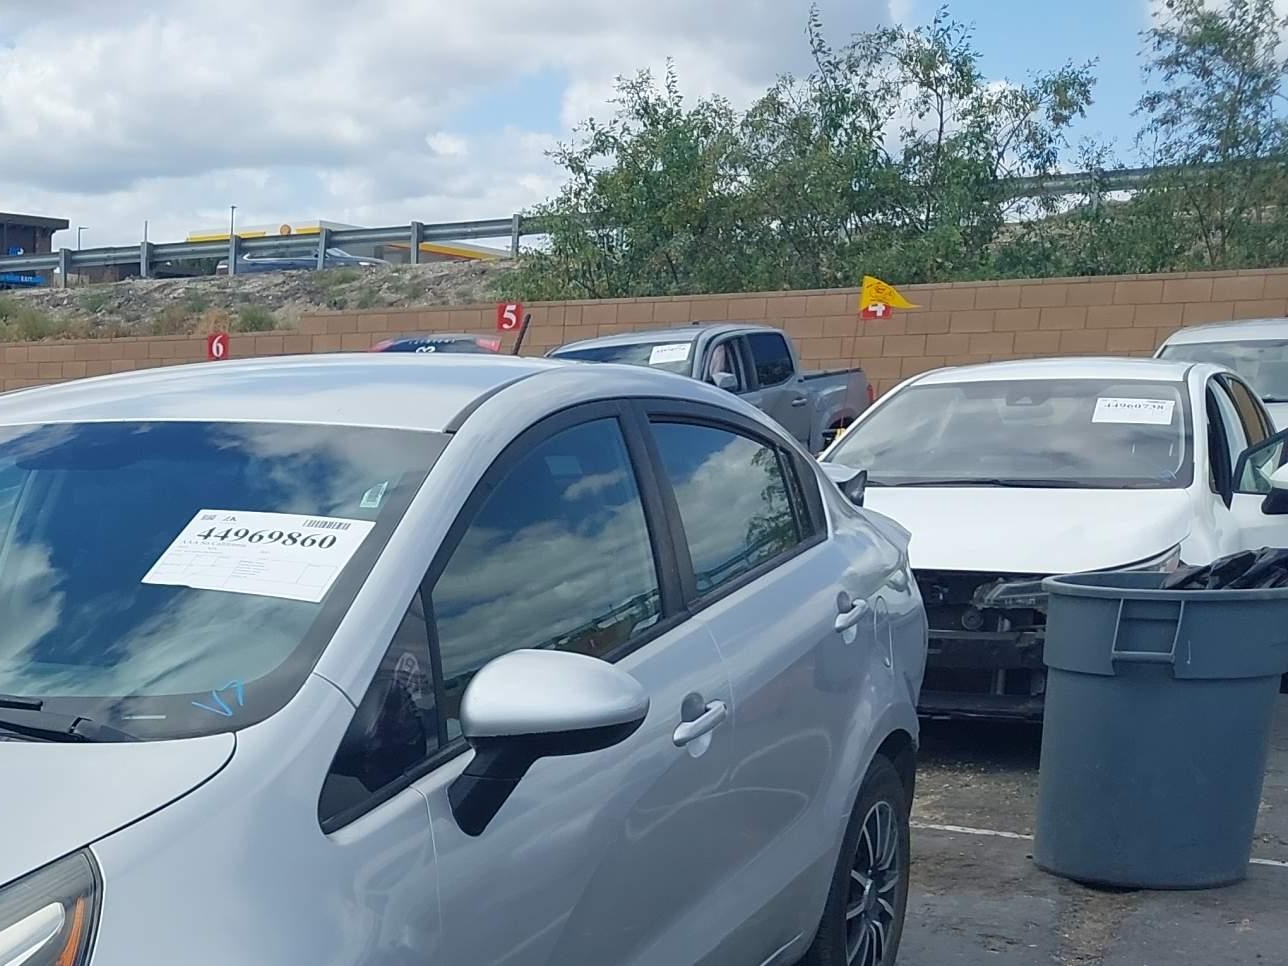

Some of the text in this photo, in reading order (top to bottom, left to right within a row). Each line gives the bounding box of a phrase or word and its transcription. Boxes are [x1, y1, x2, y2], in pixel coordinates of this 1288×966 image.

[502, 304, 517, 329] 5
[211, 334, 224, 357] 6
[197, 526, 337, 550] 44969860
